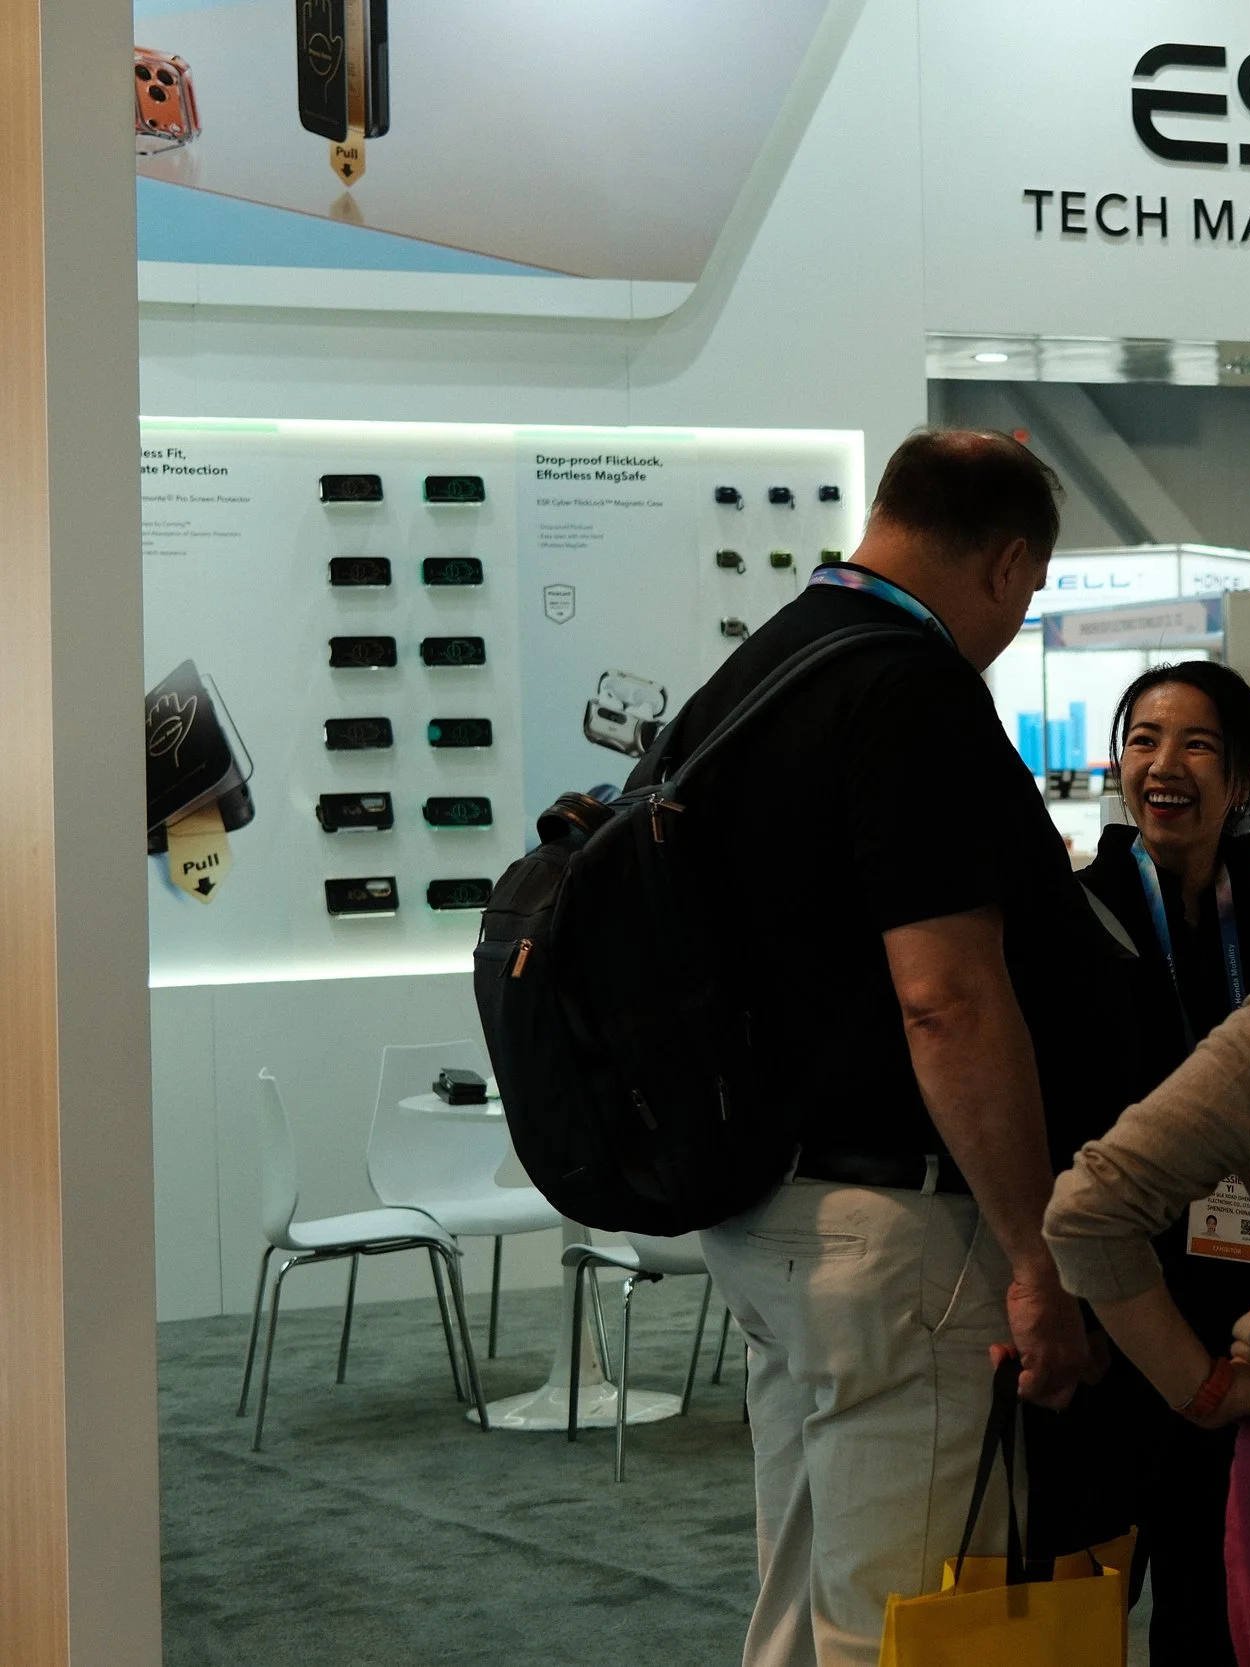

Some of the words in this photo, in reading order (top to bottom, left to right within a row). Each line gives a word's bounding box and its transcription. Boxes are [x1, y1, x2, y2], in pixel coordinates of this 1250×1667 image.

[335, 146, 358, 160] Pull
[1024, 188, 1169, 238] TECH
[167, 448, 187, 460] Fit,
[536, 455, 602, 467] Drop-proof
[606, 456, 663, 467] FlickLock,
[162, 464, 228, 475] Protection
[536, 470, 592, 480] Effortless
[595, 471, 646, 483] MagSafe
[1043, 574, 1131, 590] ELL
[183, 852, 220, 875] Pull
[1228, 943, 1239, 976] Mobility
[1232, 977, 1242, 1004] Honda
[1226, 1185, 1234, 1193] YI
[1212, 1244, 1241, 1254] EXHIBITOR
